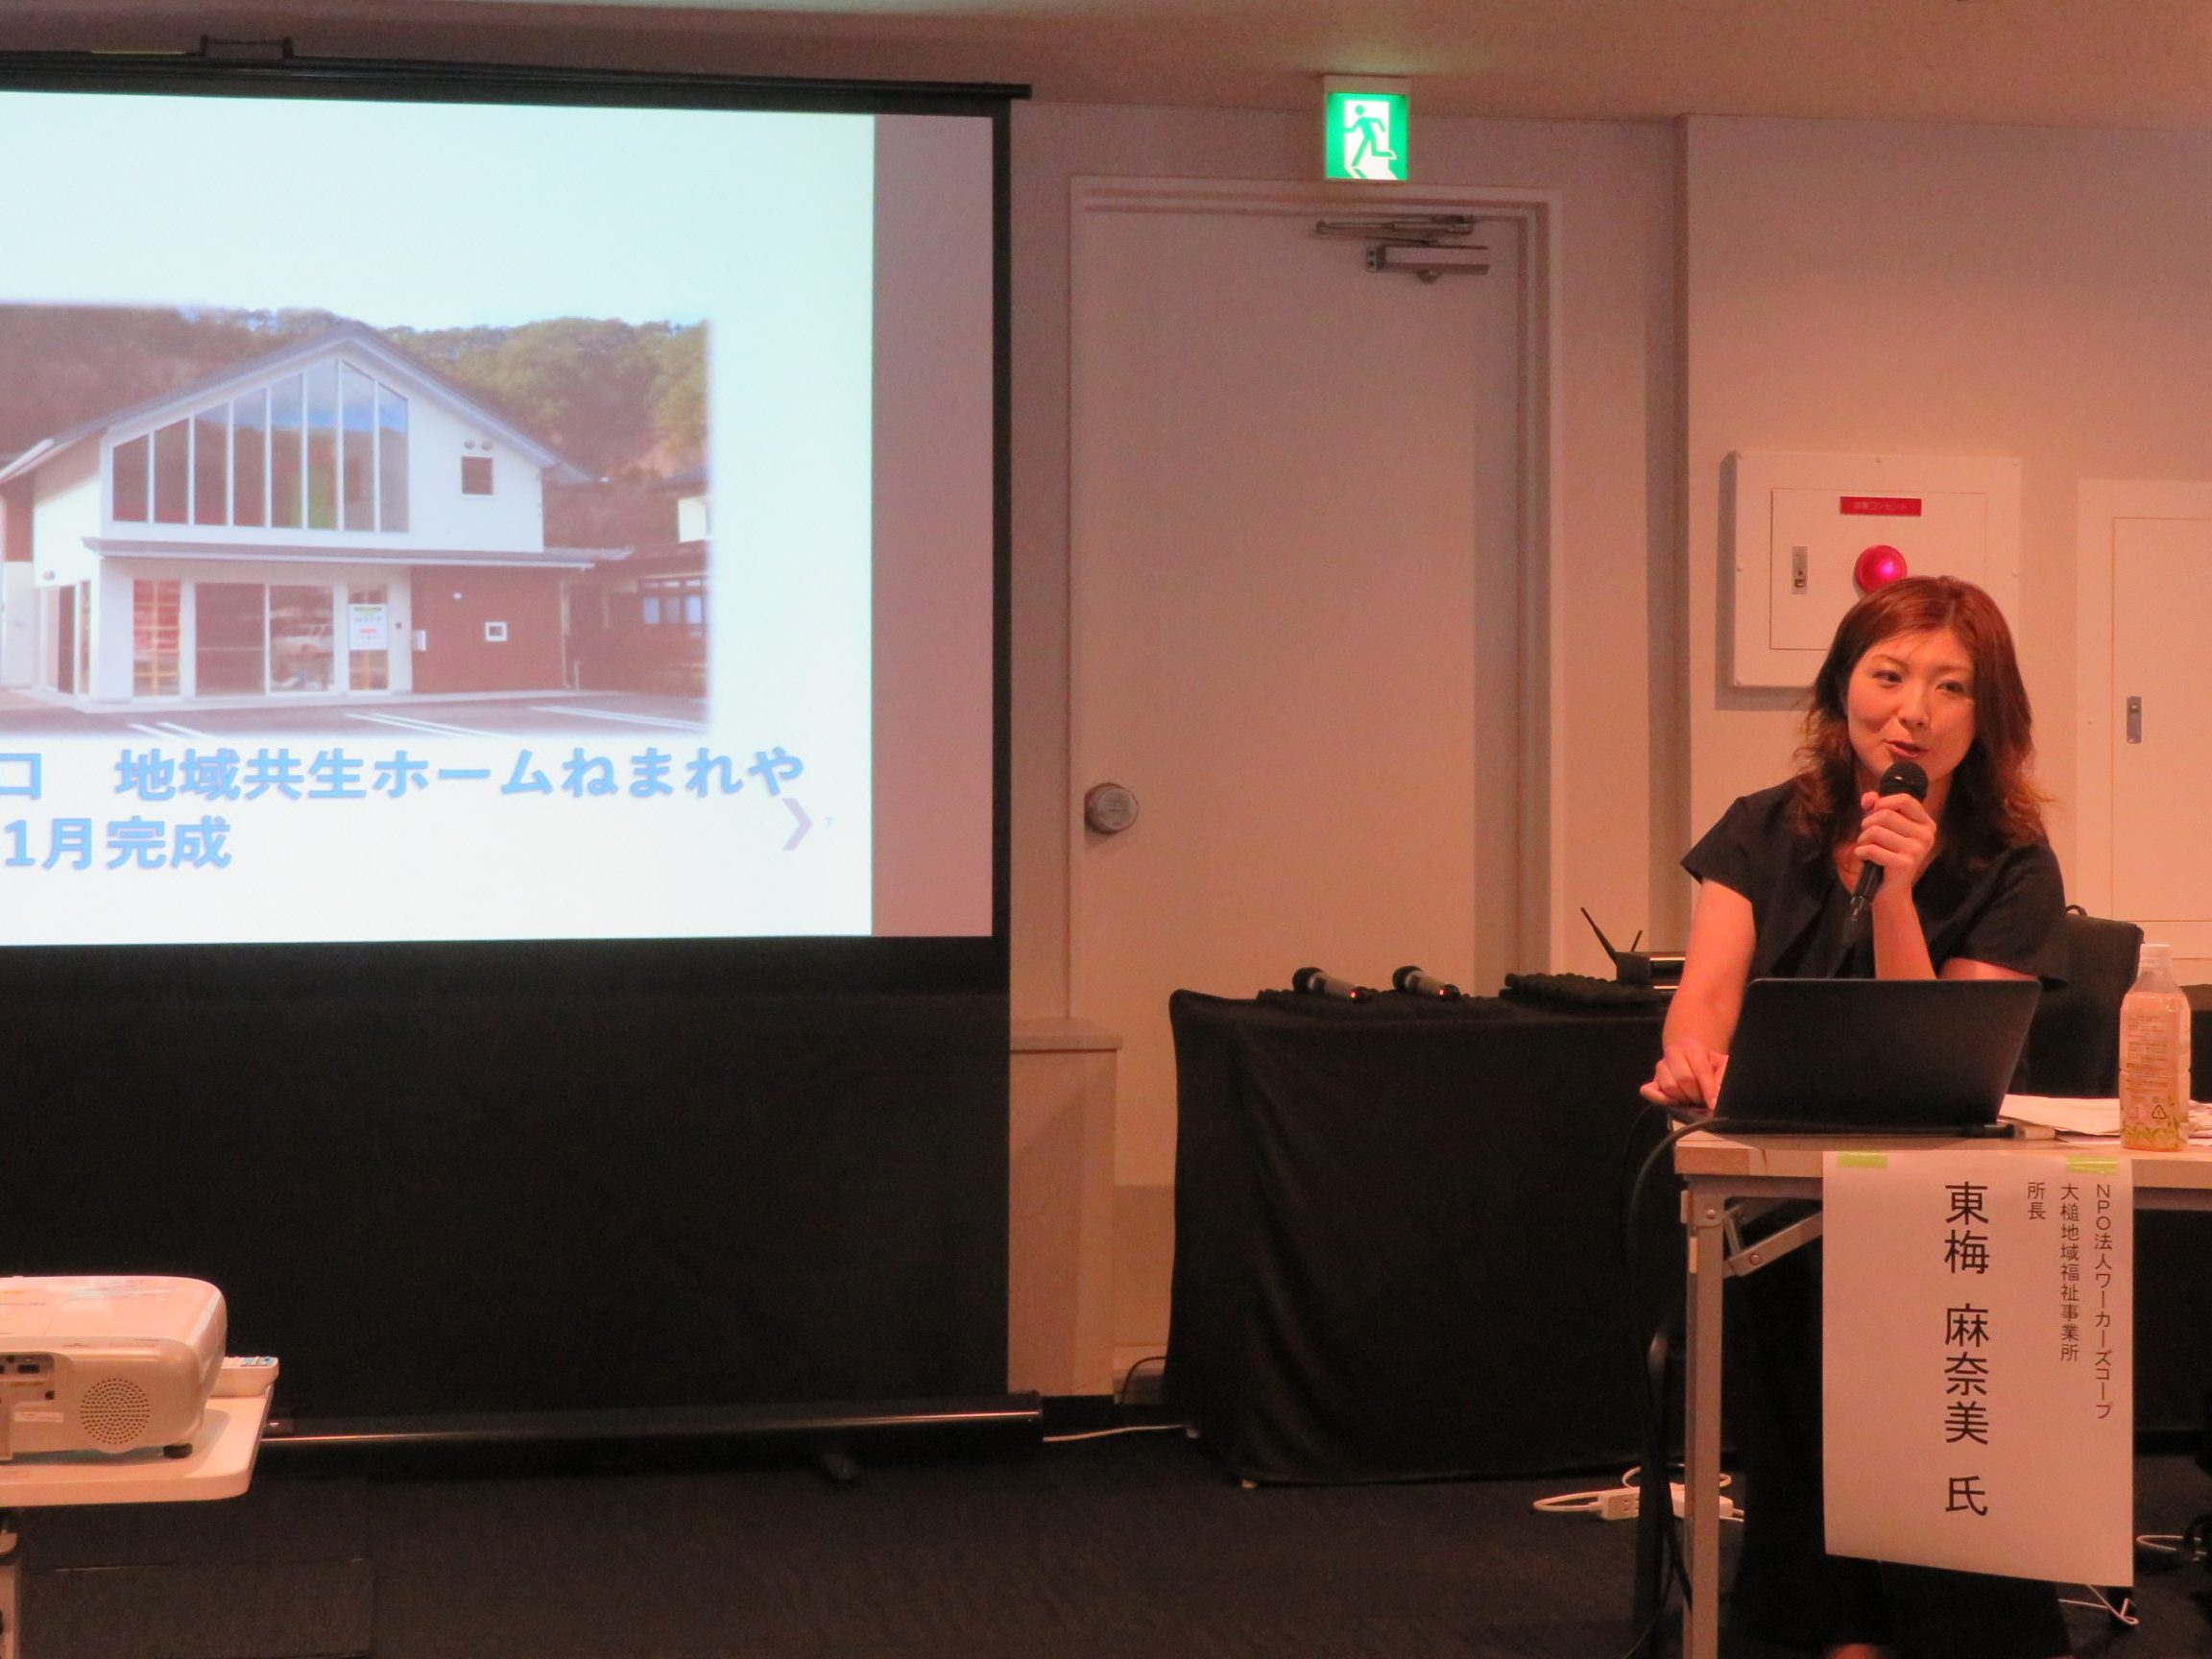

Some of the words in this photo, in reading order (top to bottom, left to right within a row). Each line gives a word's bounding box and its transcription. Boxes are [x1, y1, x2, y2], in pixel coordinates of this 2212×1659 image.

[114, 745, 805, 802] 地域共生ホームねまれや
[5, 814, 232, 871] 1月完成
[1944, 1181, 1990, 1275] 東梅
[2027, 1182, 2047, 1220] 所長
[2059, 1183, 2080, 1362] 大槌地域福祉事業所
[1944, 1302, 1990, 1446] 麻奈美
[1944, 1475, 1989, 1517] 氏
